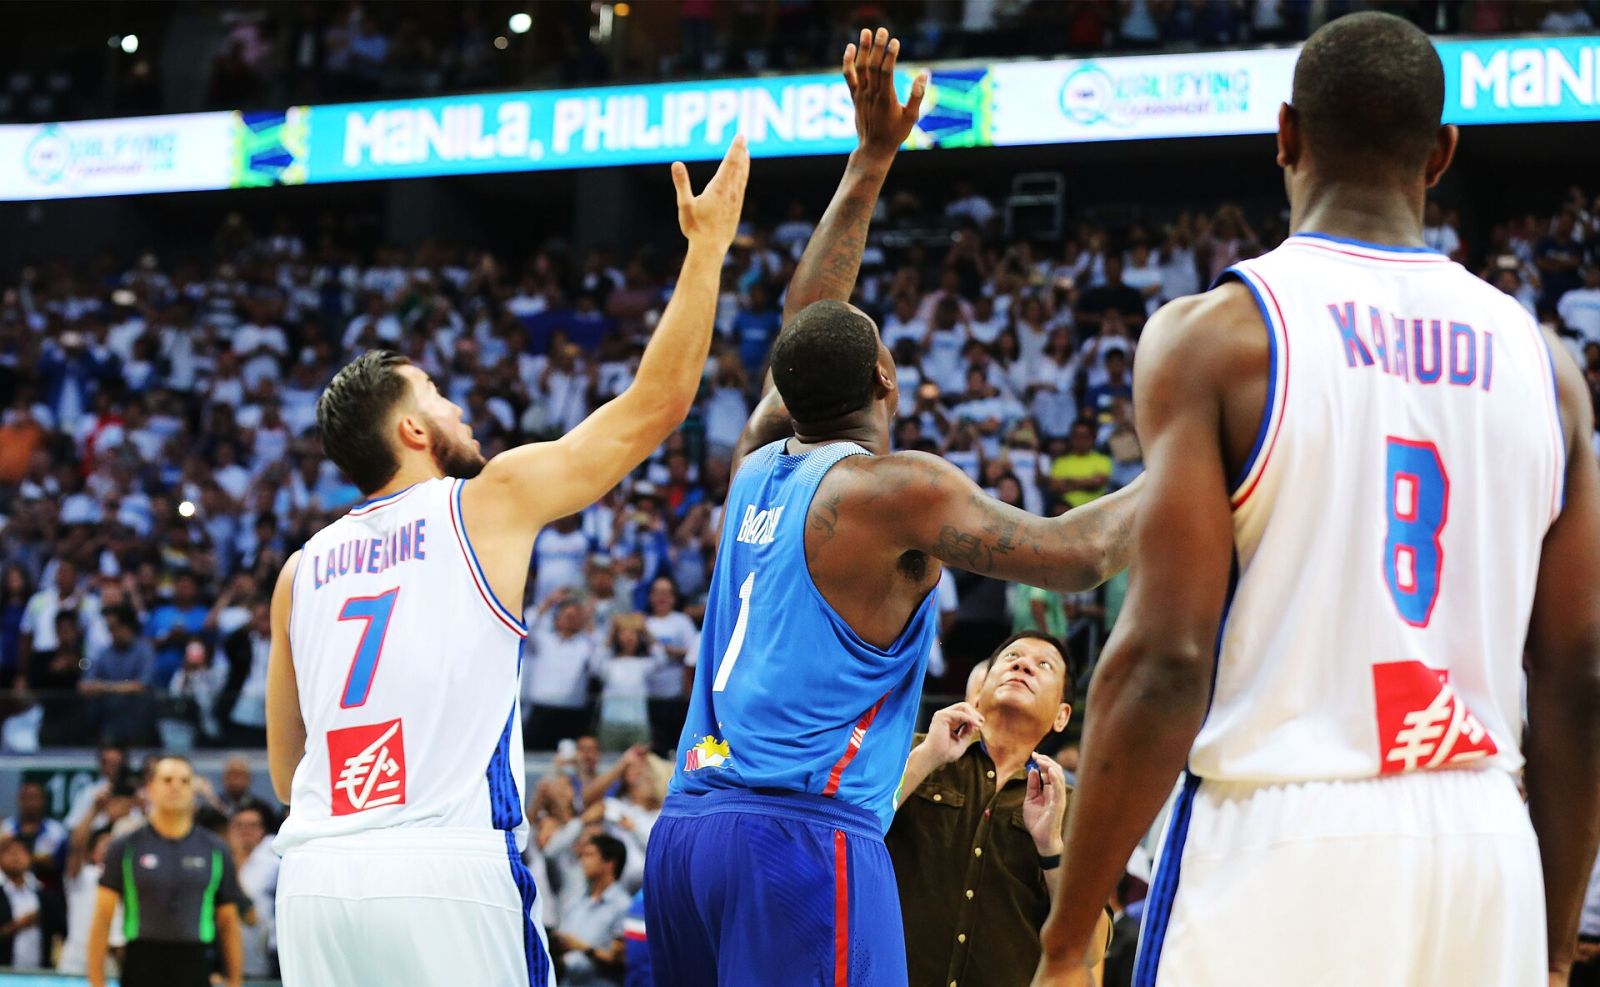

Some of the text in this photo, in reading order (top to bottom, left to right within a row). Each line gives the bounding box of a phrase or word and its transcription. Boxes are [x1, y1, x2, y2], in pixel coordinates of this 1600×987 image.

[1382, 435, 1450, 629] 8
[336, 586, 401, 710] 7
[712, 571, 756, 692] 1
